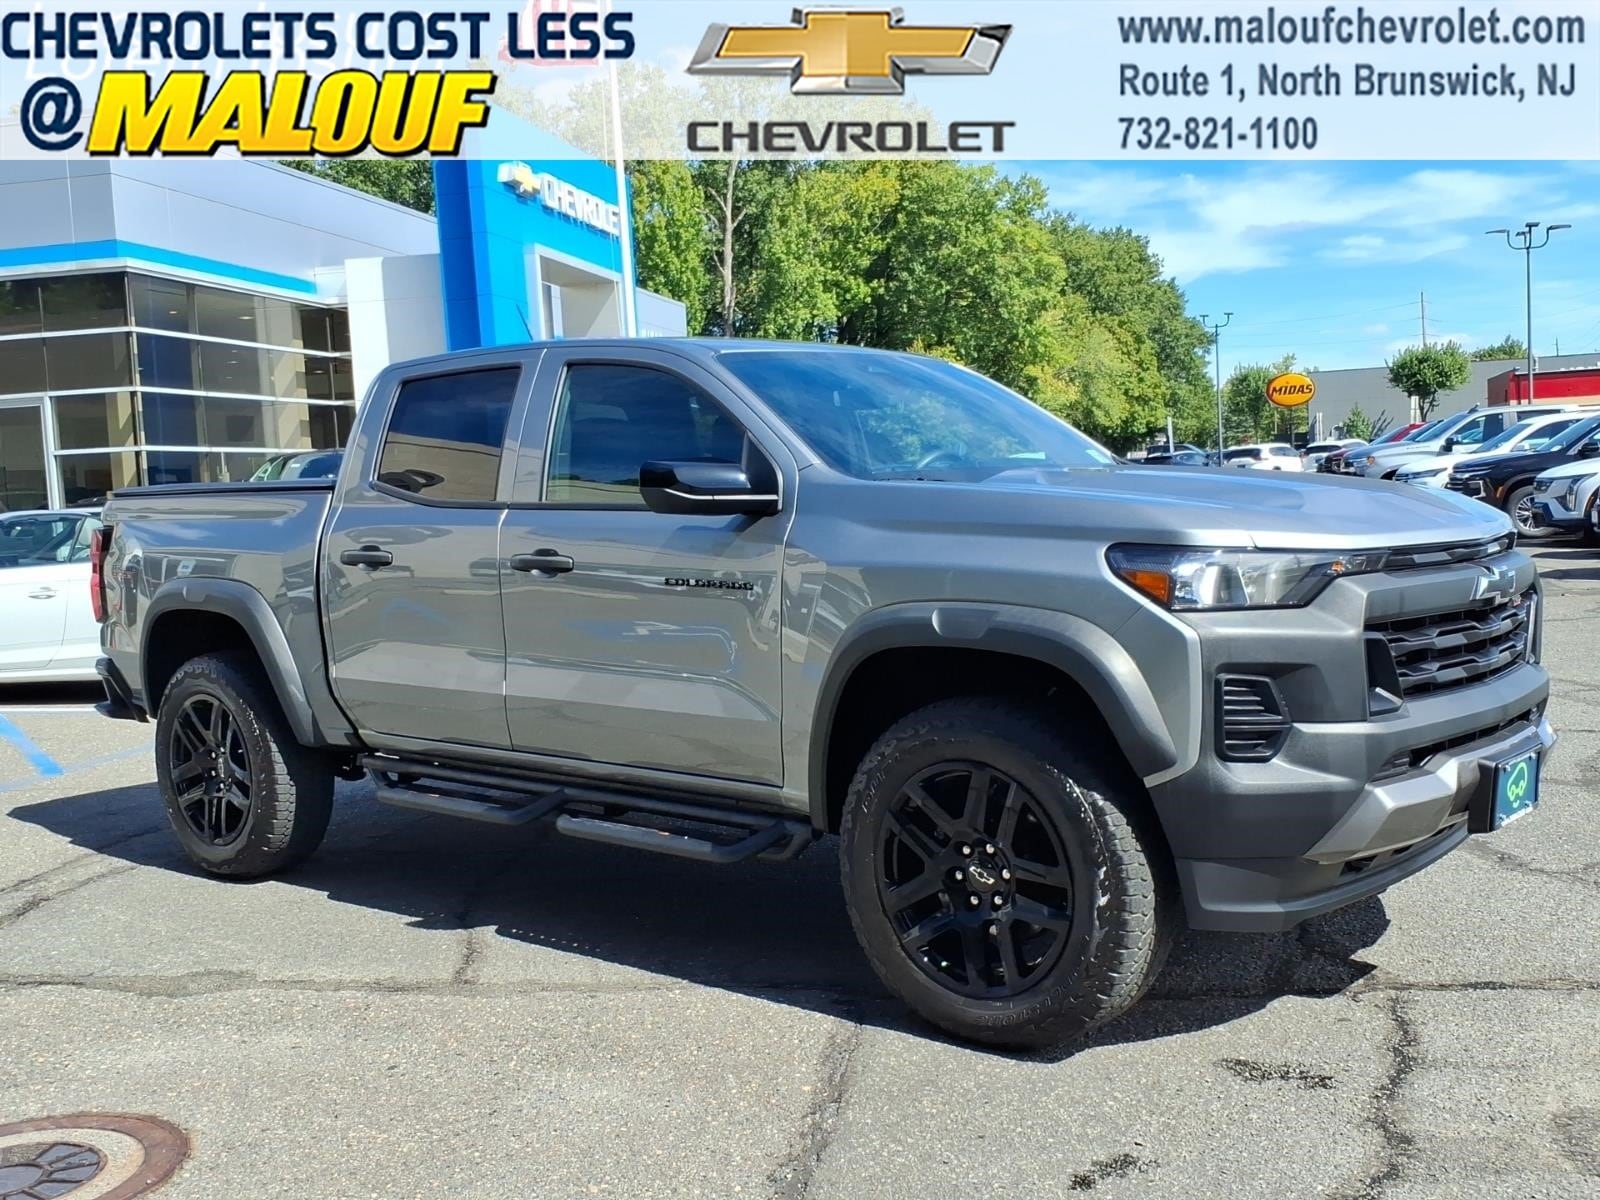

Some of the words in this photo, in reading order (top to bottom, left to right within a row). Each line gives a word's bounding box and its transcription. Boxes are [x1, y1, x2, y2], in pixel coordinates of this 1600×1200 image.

[542, 173, 621, 237] CHEVROLE
[1271, 384, 1313, 397] MIDAS
[664, 577, 754, 591] COLORADO
